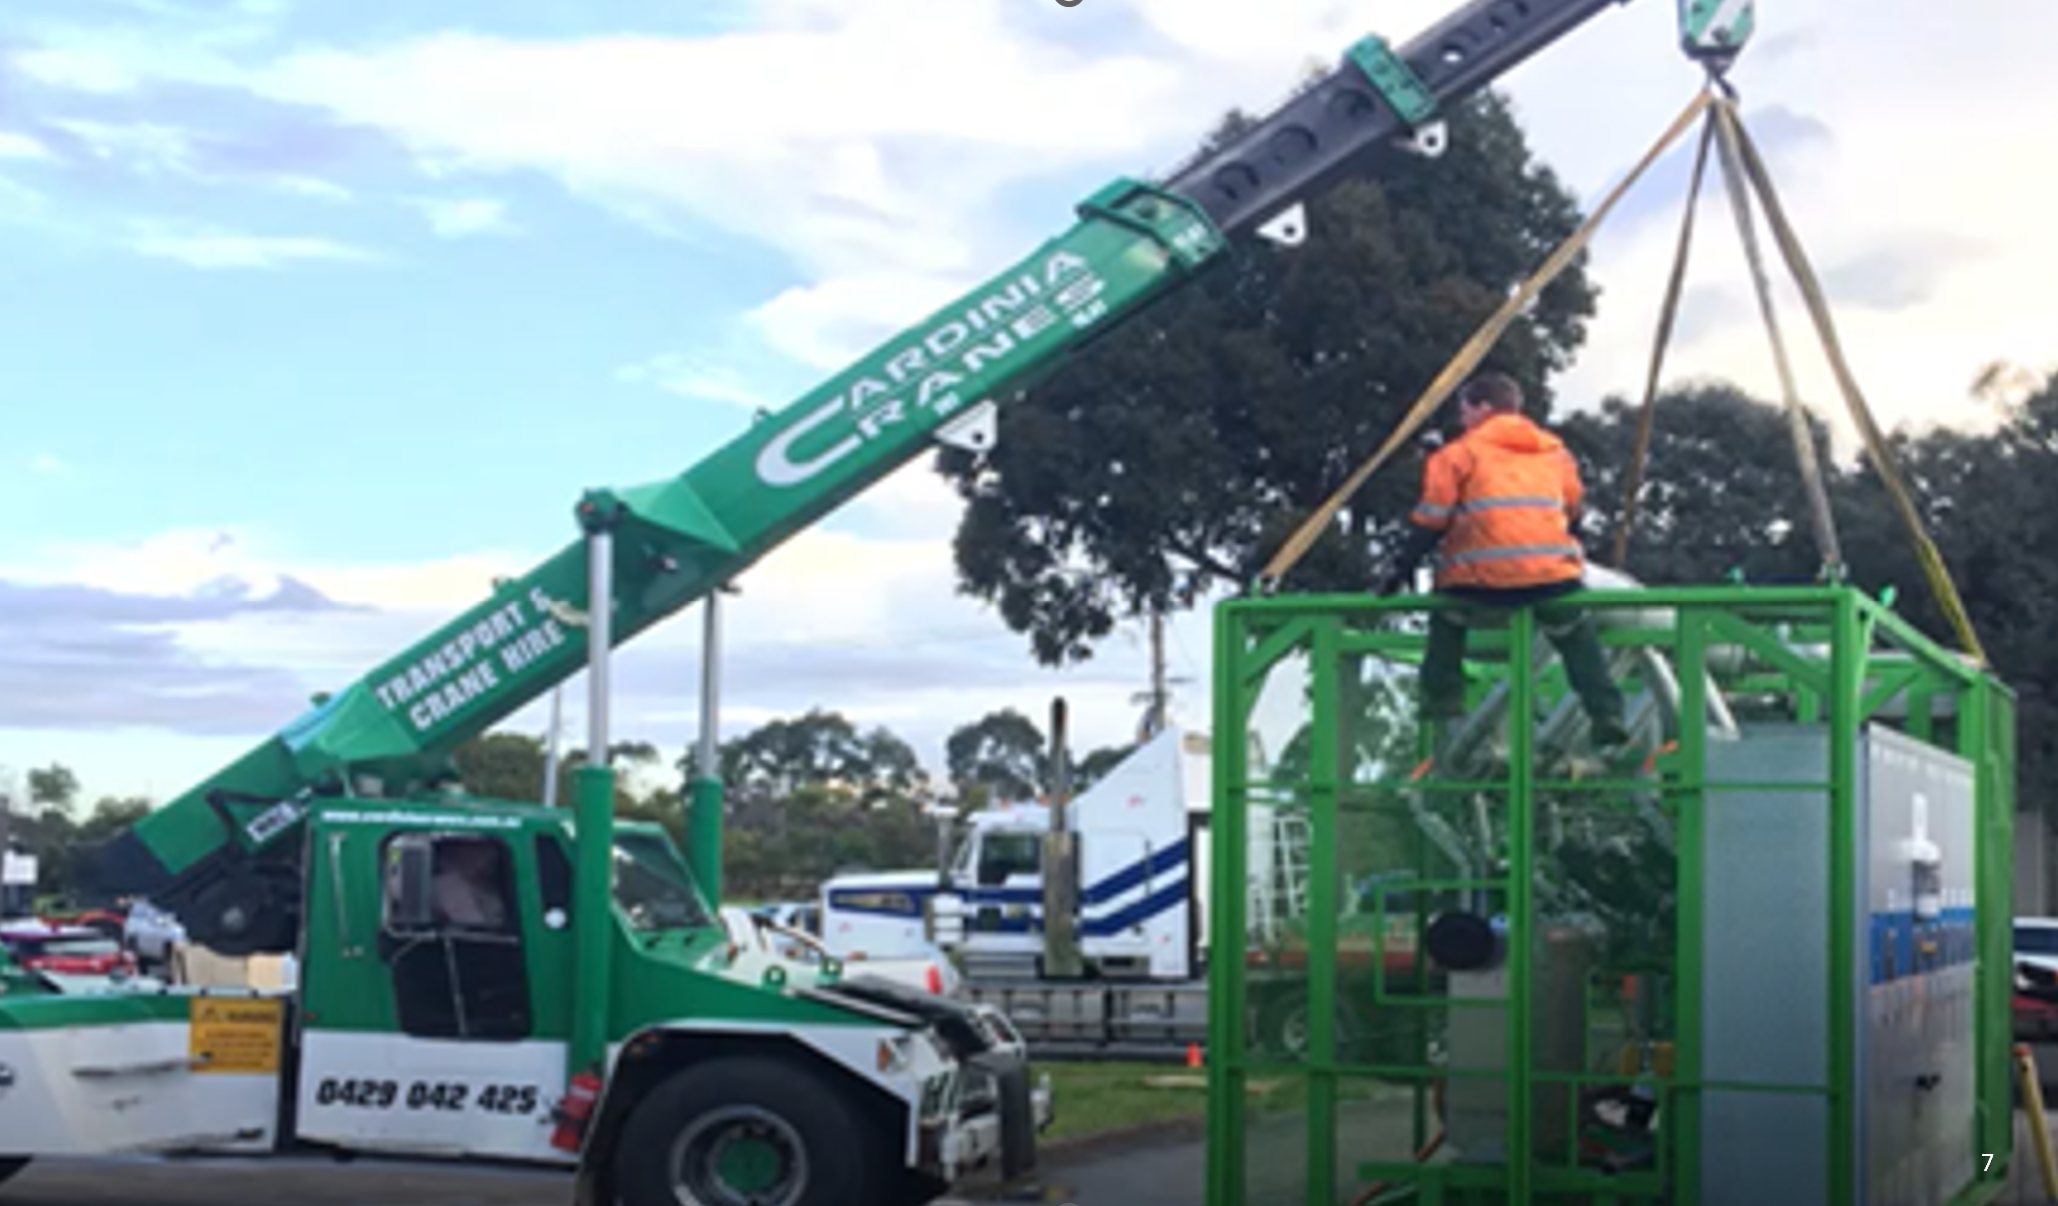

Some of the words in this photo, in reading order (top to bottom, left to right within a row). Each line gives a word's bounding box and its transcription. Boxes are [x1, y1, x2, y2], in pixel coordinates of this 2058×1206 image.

[755, 250, 1086, 486] CARDINIA
[375, 599, 525, 709] TRANSPORT
[409, 659, 499, 730] CRANE
[500, 619, 565, 673] HIRE
[315, 1078, 398, 1110] 0429
[406, 1080, 469, 1111] 042
[477, 1084, 538, 1115] 425
